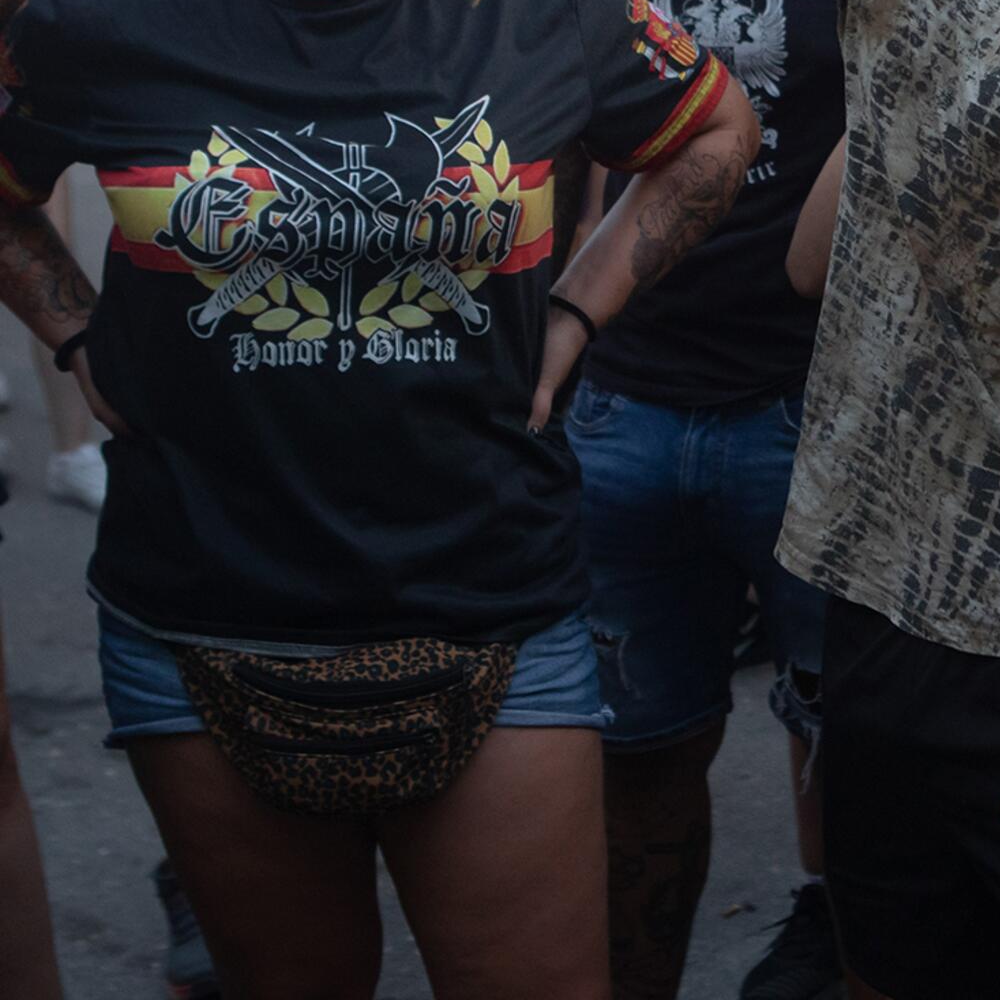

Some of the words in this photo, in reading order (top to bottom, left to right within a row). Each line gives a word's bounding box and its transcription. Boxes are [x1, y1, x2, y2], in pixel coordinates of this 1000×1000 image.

[746, 160, 777, 185] rir
[153, 175, 521, 281] España
[230, 331, 330, 373] Honor
[338, 338, 357, 373] y
[361, 327, 458, 365] Gloria
